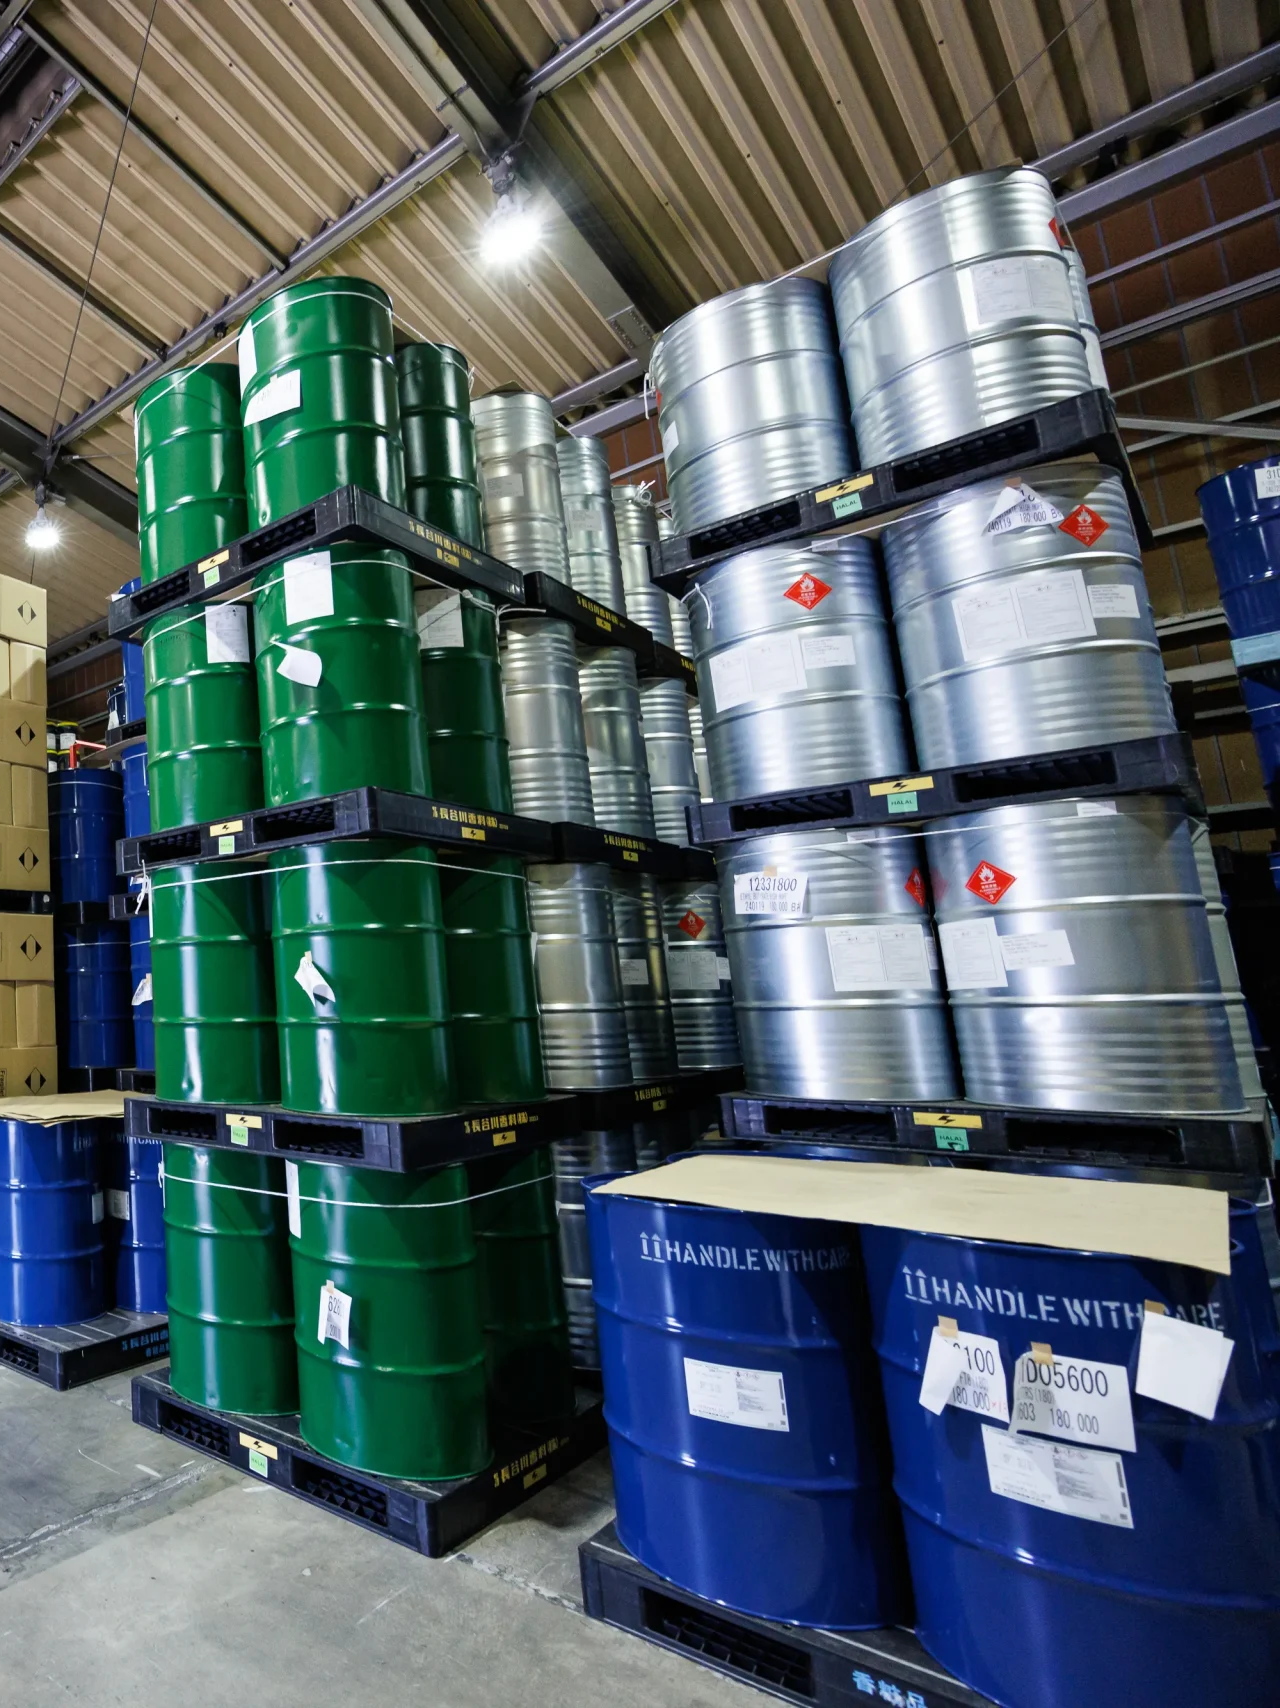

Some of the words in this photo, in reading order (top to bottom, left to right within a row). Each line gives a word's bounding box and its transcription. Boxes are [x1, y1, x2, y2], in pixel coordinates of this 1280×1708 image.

[836, 499, 858, 511] HALAL
[749, 877, 797, 891] 12331800
[664, 1240, 760, 1271] HANDLE
[763, 1249, 814, 1272] WITH
[932, 1275, 1059, 1323] HANDLE
[1063, 1297, 1143, 1331] WITH
[1160, 1299, 1224, 1332] ARE
[952, 1342, 995, 1376] 100
